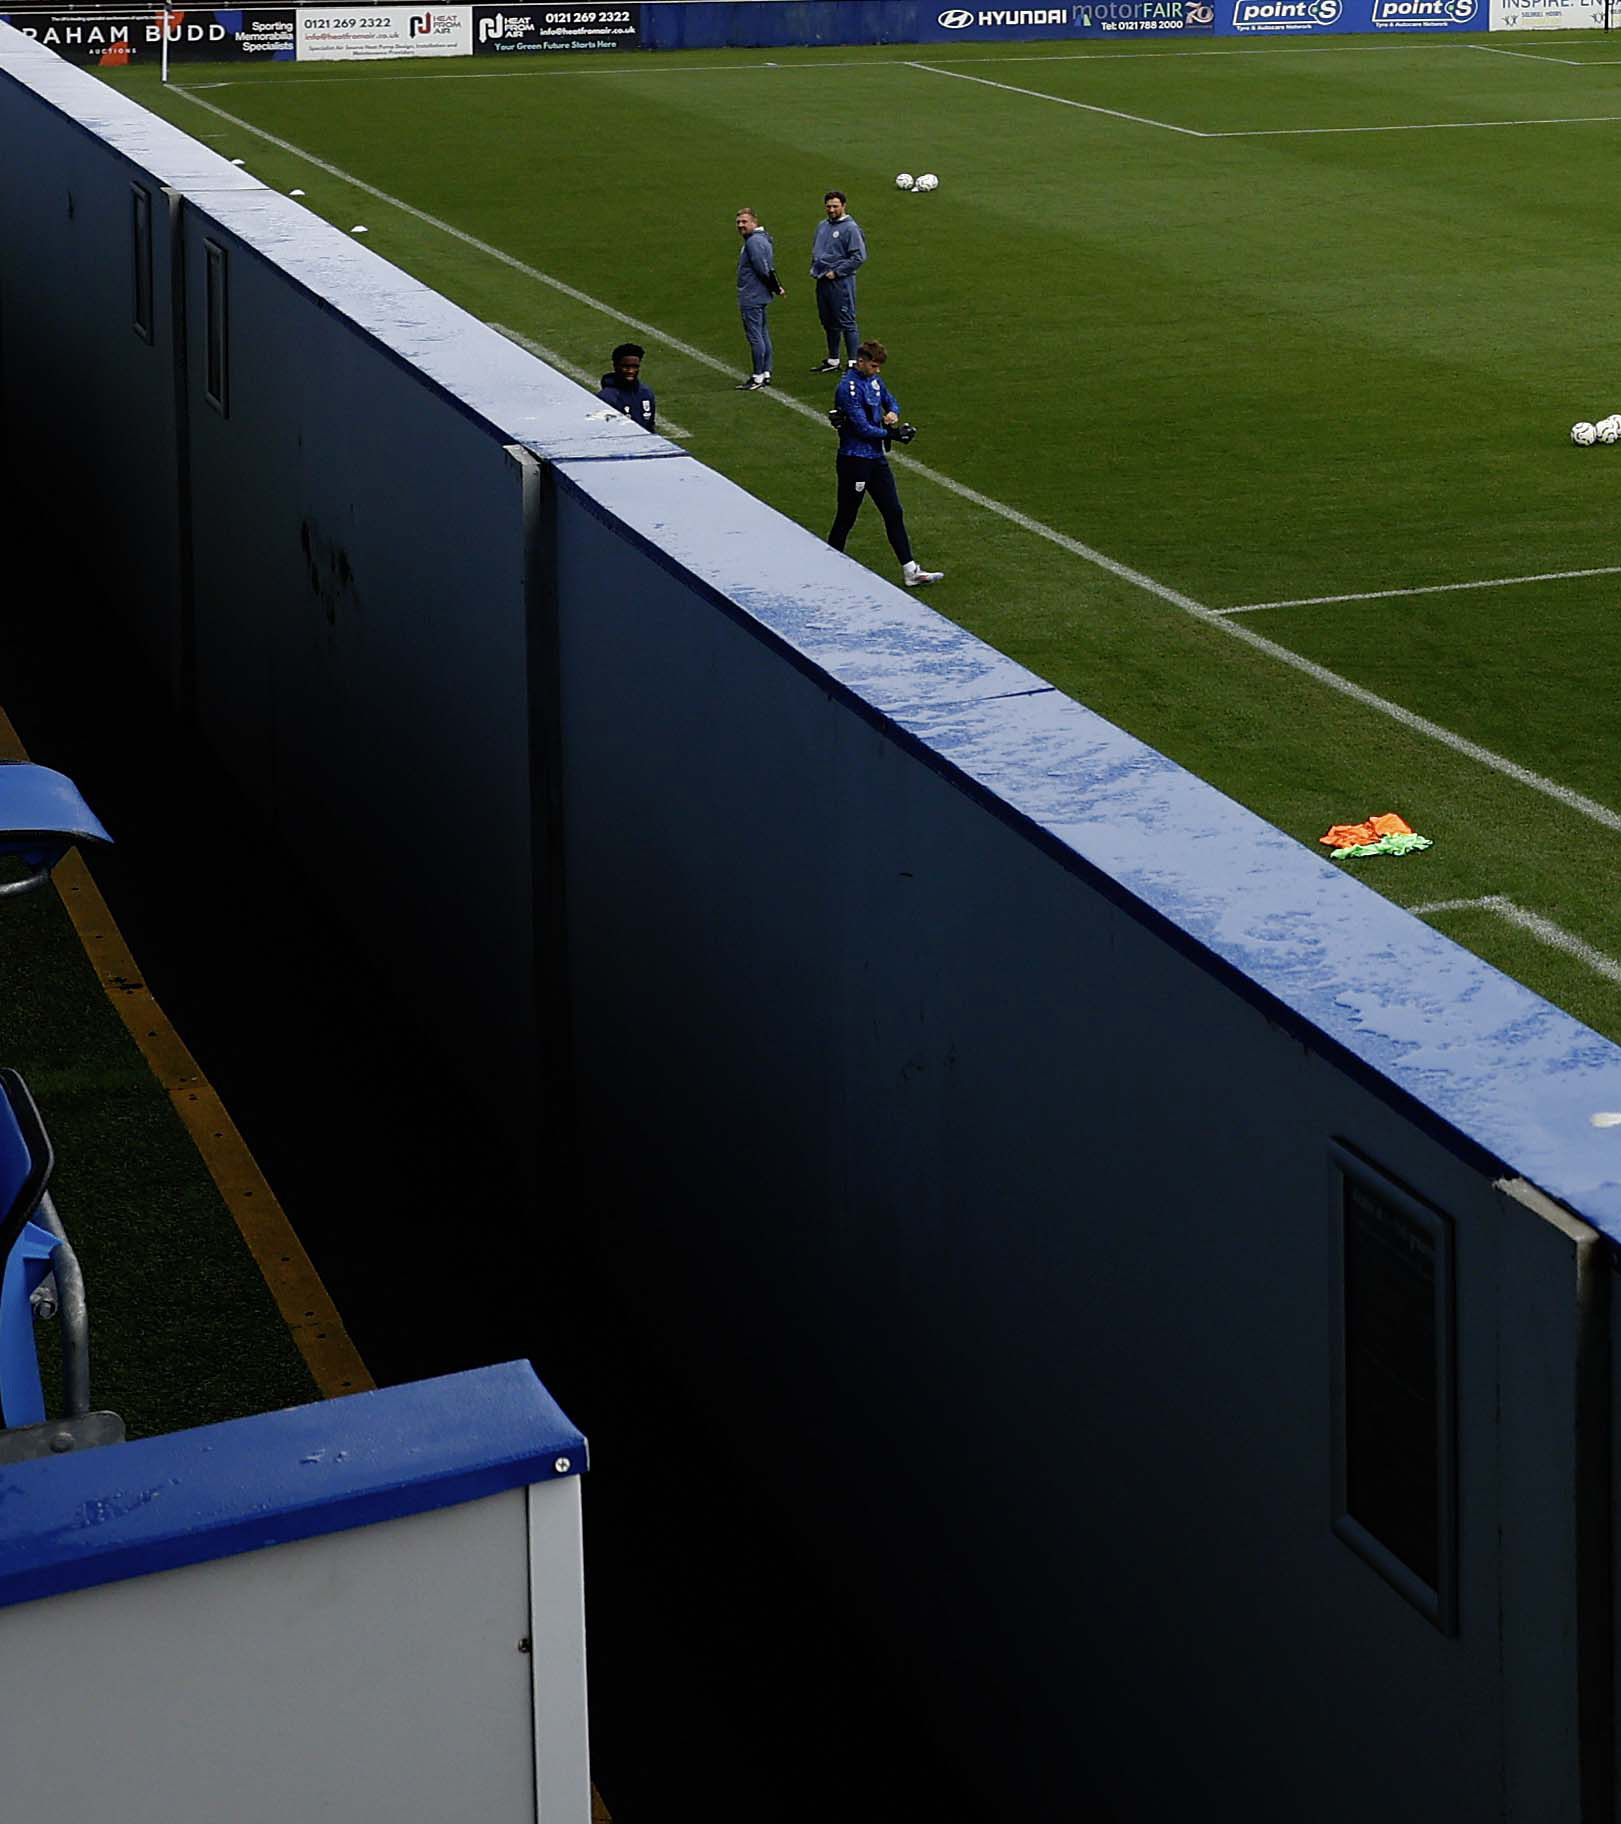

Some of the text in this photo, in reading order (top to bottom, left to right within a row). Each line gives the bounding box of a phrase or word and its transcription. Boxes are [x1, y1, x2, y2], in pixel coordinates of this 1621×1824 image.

[1072, 2, 1183, 19] motorFAIR
[1244, 0, 1337, 21] point S
[1382, 0, 1442, 18] point
[546, 11, 630, 23] 0121 269 2322
[978, 9, 1067, 25] HYUNDAI
[252, 21, 293, 32] Sporting
[304, 18, 391, 29] 0121 269 2322
[1118, 21, 1138, 31] 0121
[1138, 21, 1157, 30] 788
[1158, 20, 1183, 29] 2000
[22, 24, 226, 44] RAHAM BUDD
[235, 31, 294, 42] Memorabilia
[89, 47, 137, 55] AUCTIONS
[242, 41, 294, 52] Specialists
[494, 40, 617, 52] Your Green Future Starts Here
